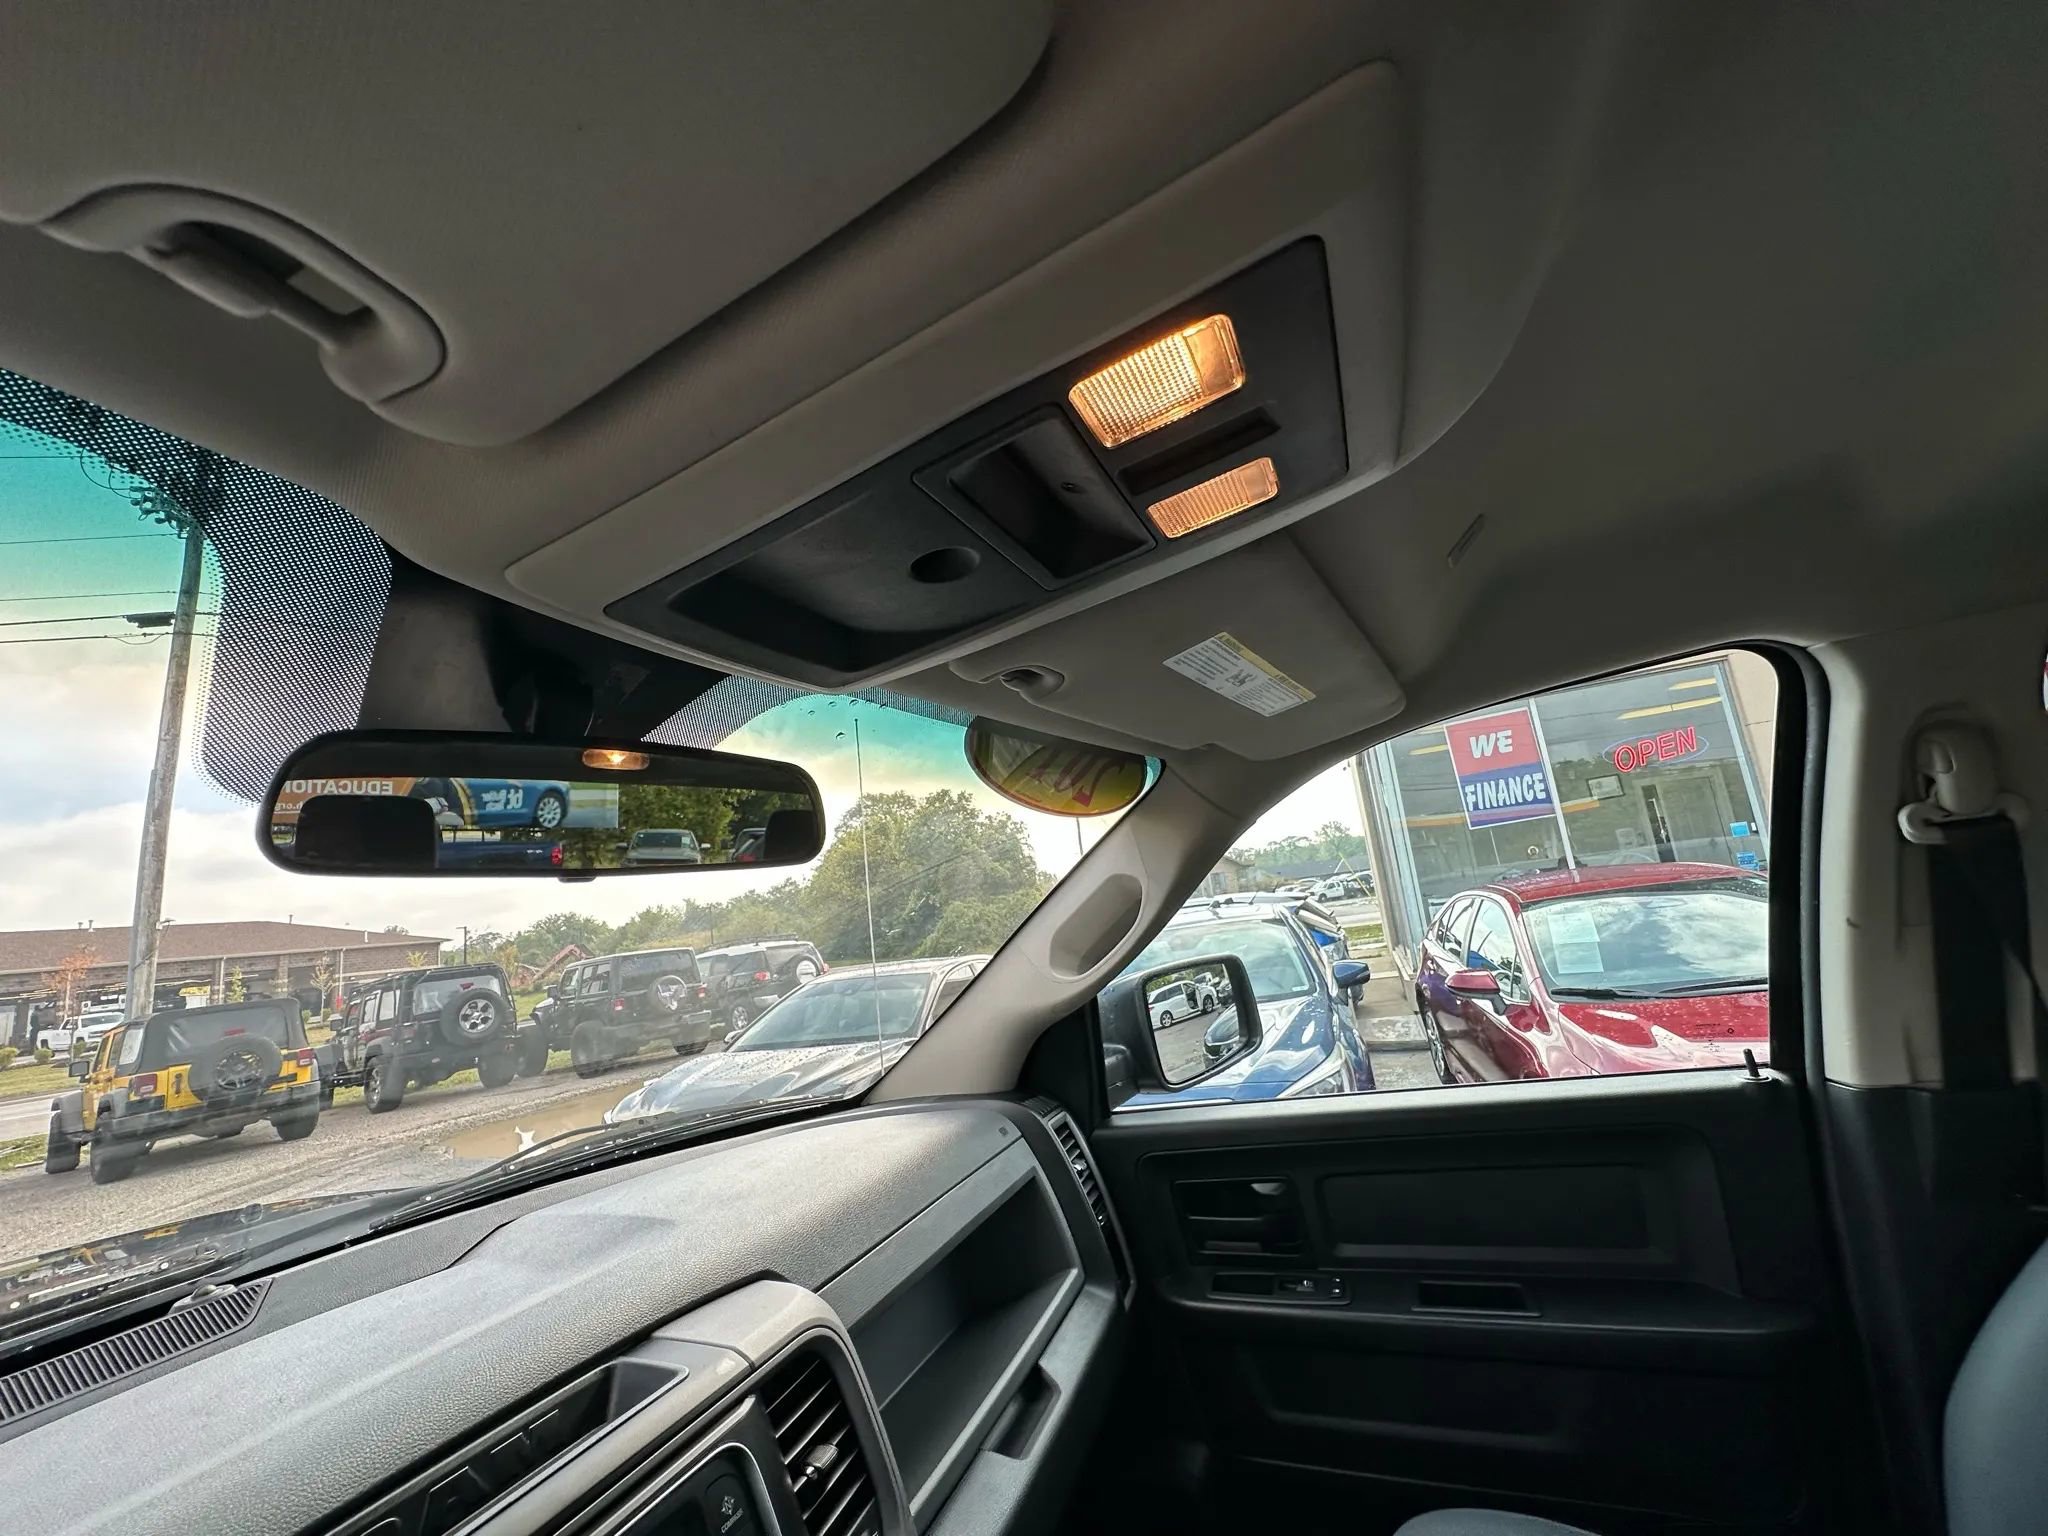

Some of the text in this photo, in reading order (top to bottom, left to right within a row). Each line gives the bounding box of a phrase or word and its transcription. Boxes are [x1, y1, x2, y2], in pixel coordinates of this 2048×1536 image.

[1469, 729, 1513, 759] WE
[1613, 726, 1698, 773] OPEN
[1463, 772, 1546, 812] FINANCE
